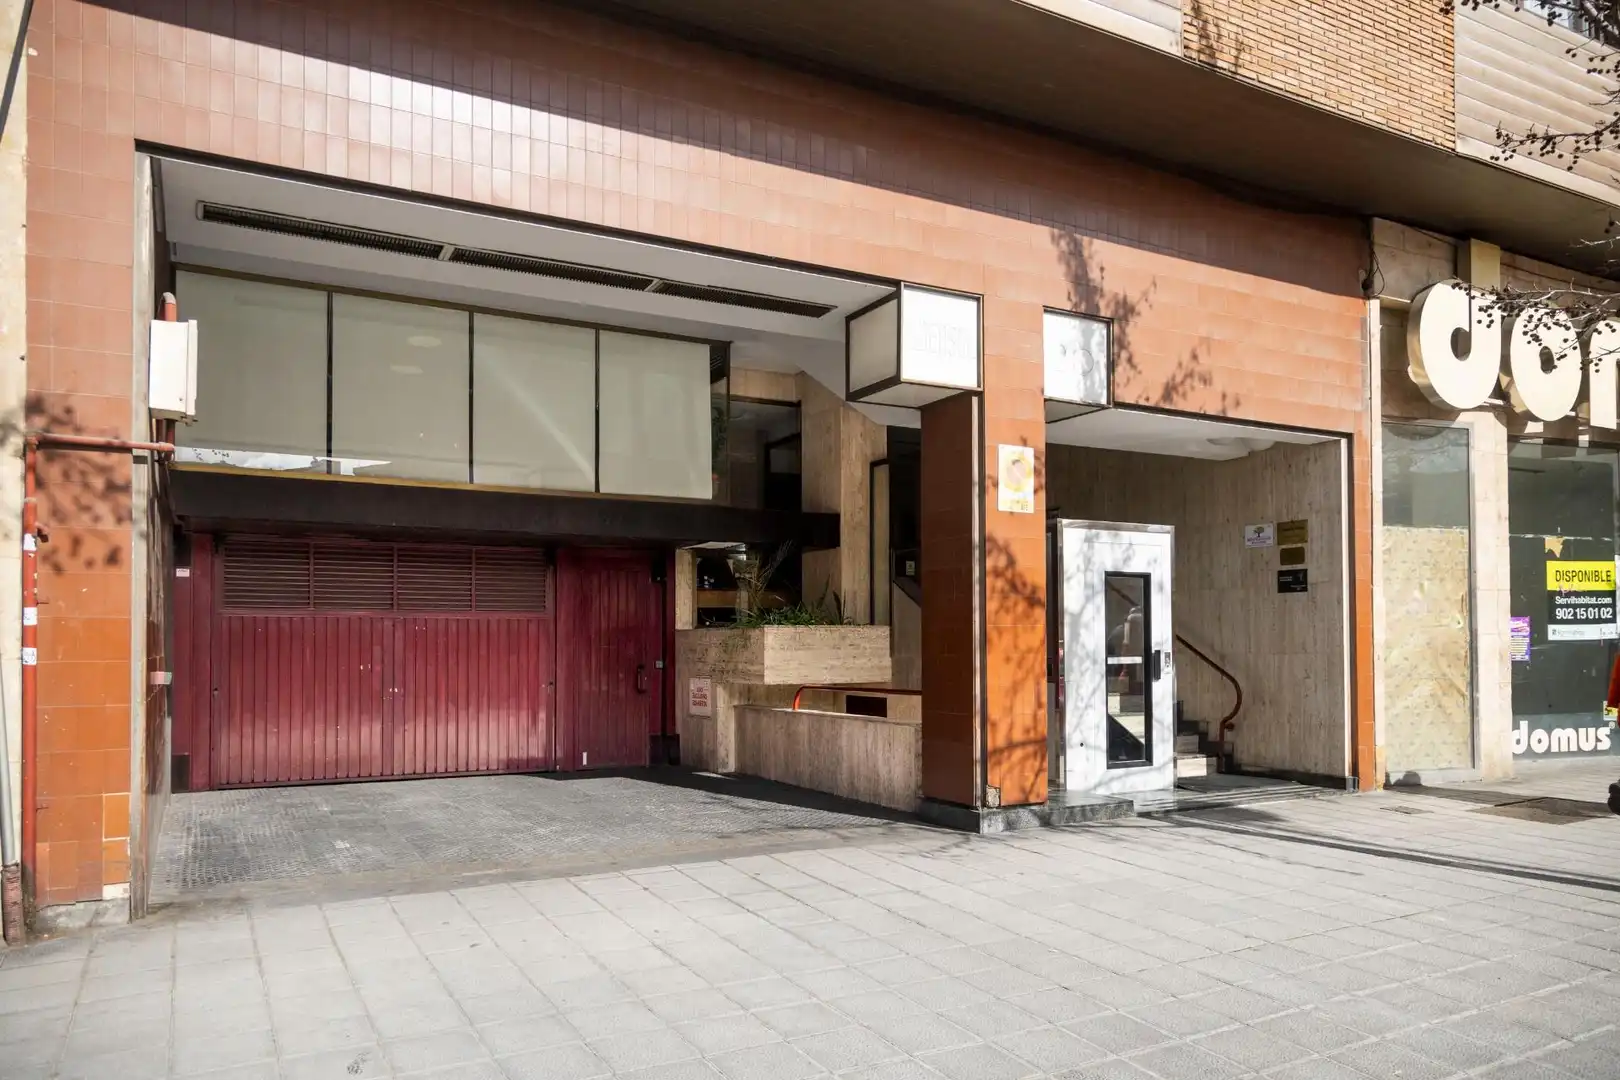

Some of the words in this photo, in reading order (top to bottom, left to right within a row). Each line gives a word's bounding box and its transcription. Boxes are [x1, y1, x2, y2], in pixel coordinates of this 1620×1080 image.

[1554, 569, 1612, 583] DISPONIBLE
[1555, 596, 1613, 605] Servihabitat.com
[1555, 608, 1574, 620] 902
[1575, 608, 1587, 619] 15
[1588, 608, 1599, 619] 01
[1600, 607, 1613, 618] 02
